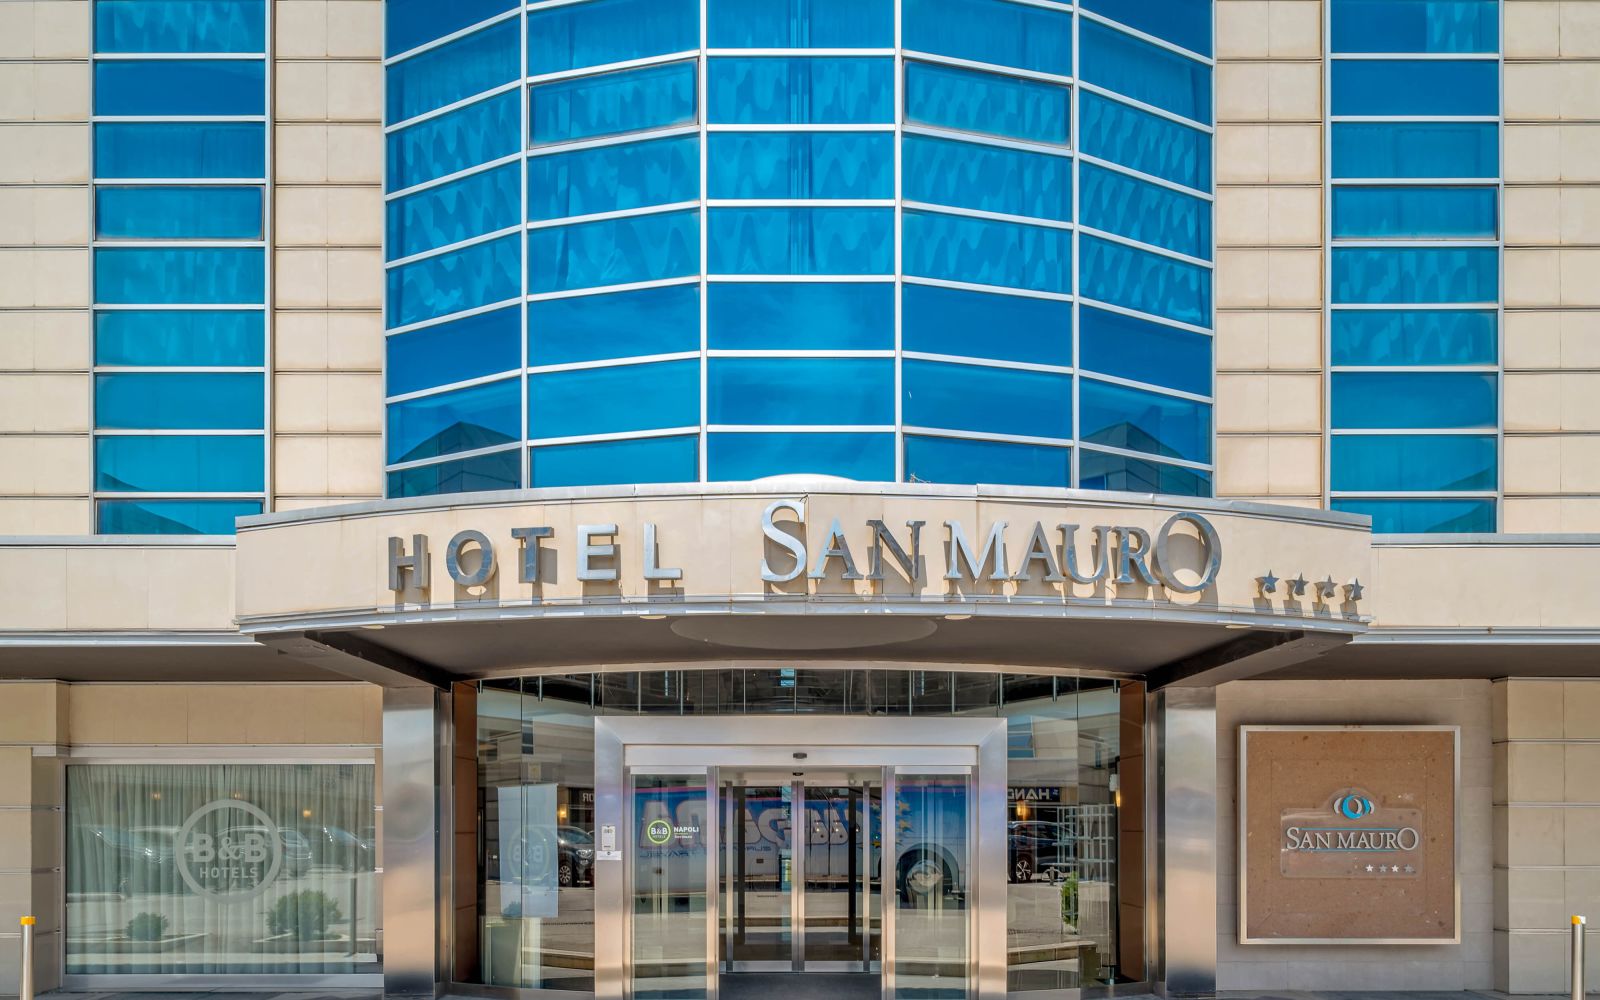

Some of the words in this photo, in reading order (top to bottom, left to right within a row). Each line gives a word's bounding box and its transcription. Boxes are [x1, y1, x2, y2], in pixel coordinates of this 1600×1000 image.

[388, 523, 683, 592] HOTEL
[761, 499, 926, 583] SAN
[943, 511, 1222, 594] MAURO
[193, 833, 267, 863] B&B
[1286, 826, 1332, 850] SAN
[1338, 827, 1420, 851] MAURO
[200, 867, 259, 879] HOTELS
